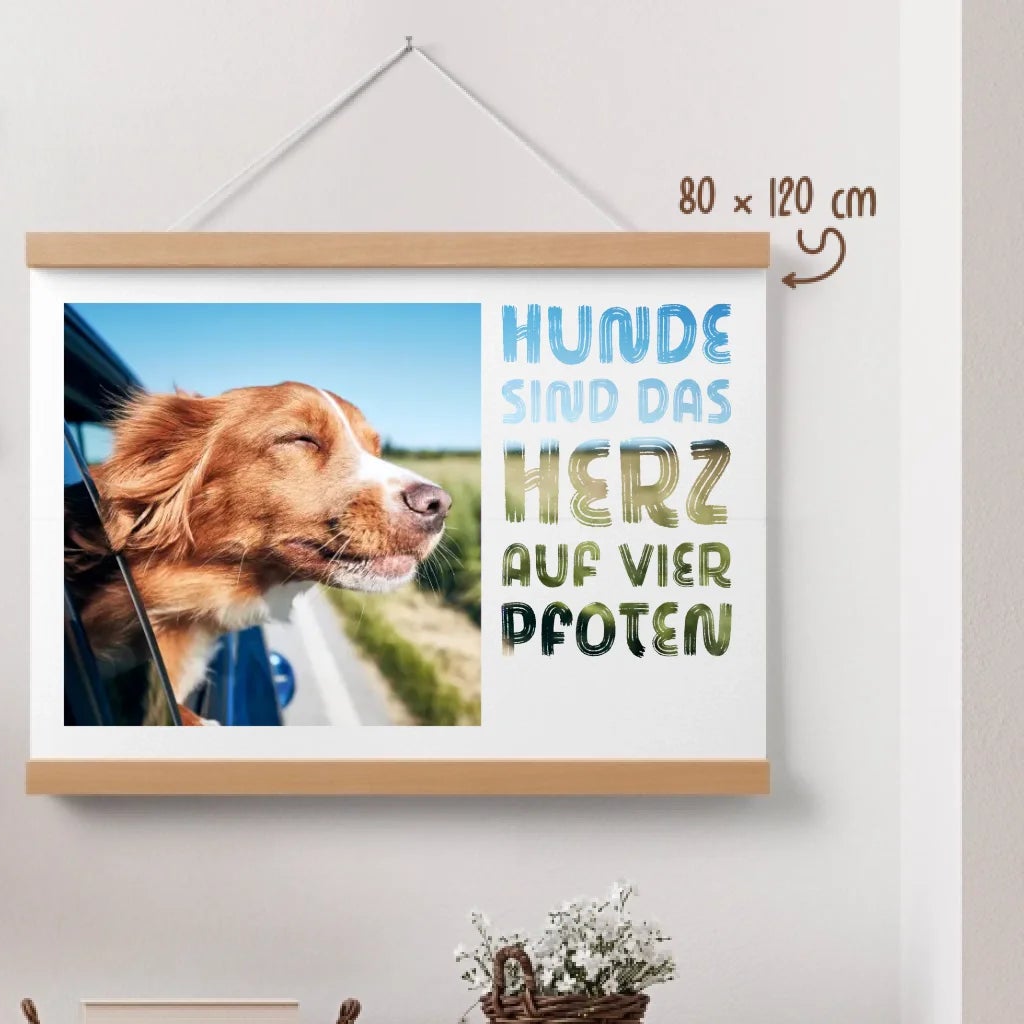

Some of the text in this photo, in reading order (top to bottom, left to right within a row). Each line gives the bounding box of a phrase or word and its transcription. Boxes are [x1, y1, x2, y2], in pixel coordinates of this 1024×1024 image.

[502, 304, 731, 365] HUNDE
[502, 378, 731, 424] SIND DAS
[503, 437, 731, 528] HERZ
[502, 541, 731, 588] AUF VIER
[501, 601, 732, 658] PFOTEN
